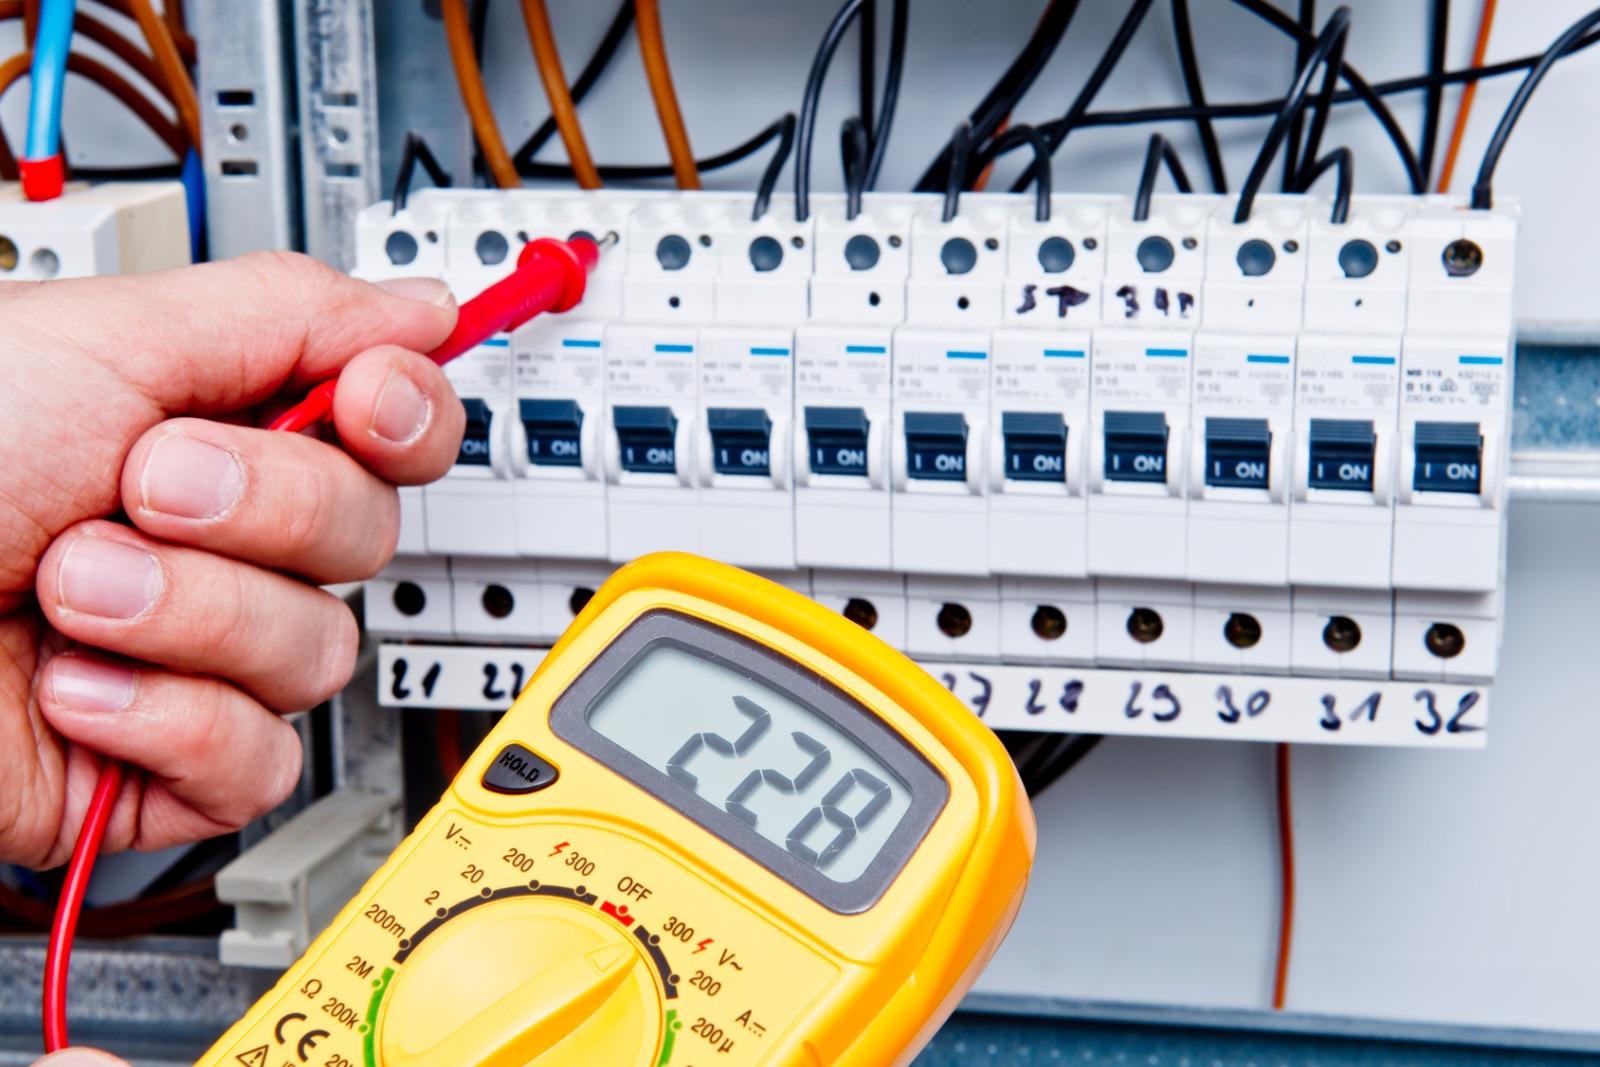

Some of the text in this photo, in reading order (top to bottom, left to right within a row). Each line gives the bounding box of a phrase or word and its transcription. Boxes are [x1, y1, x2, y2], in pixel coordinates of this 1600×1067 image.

[460, 437, 490, 455] ON
[551, 440, 578, 456] ON
[646, 445, 676, 464] ON
[740, 449, 770, 466] ON
[836, 449, 864, 466] ON
[935, 454, 963, 471] ON
[1033, 454, 1062, 472] ON
[1133, 455, 1163, 472] ON
[1235, 461, 1265, 478] ON
[1338, 463, 1368, 480] ON
[1446, 463, 1477, 480] ON
[391, 658, 441, 700] 21
[1217, 686, 1271, 724] 30
[1414, 689, 1485, 736] 32
[499, 750, 541, 785] HOLD
[665, 694, 893, 870] 228
[502, 847, 536, 874] 200
[565, 850, 597, 878] 300
[460, 863, 486, 885] 20
[424, 889, 441, 907] 2
[616, 875, 654, 903] OFF
[364, 903, 407, 939] 200m
[662, 915, 696, 944] 300
[345, 955, 376, 980] 2M
[687, 969, 723, 998] 200
[320, 996, 361, 1031] 200k
[273, 1011, 332, 1063] CE
